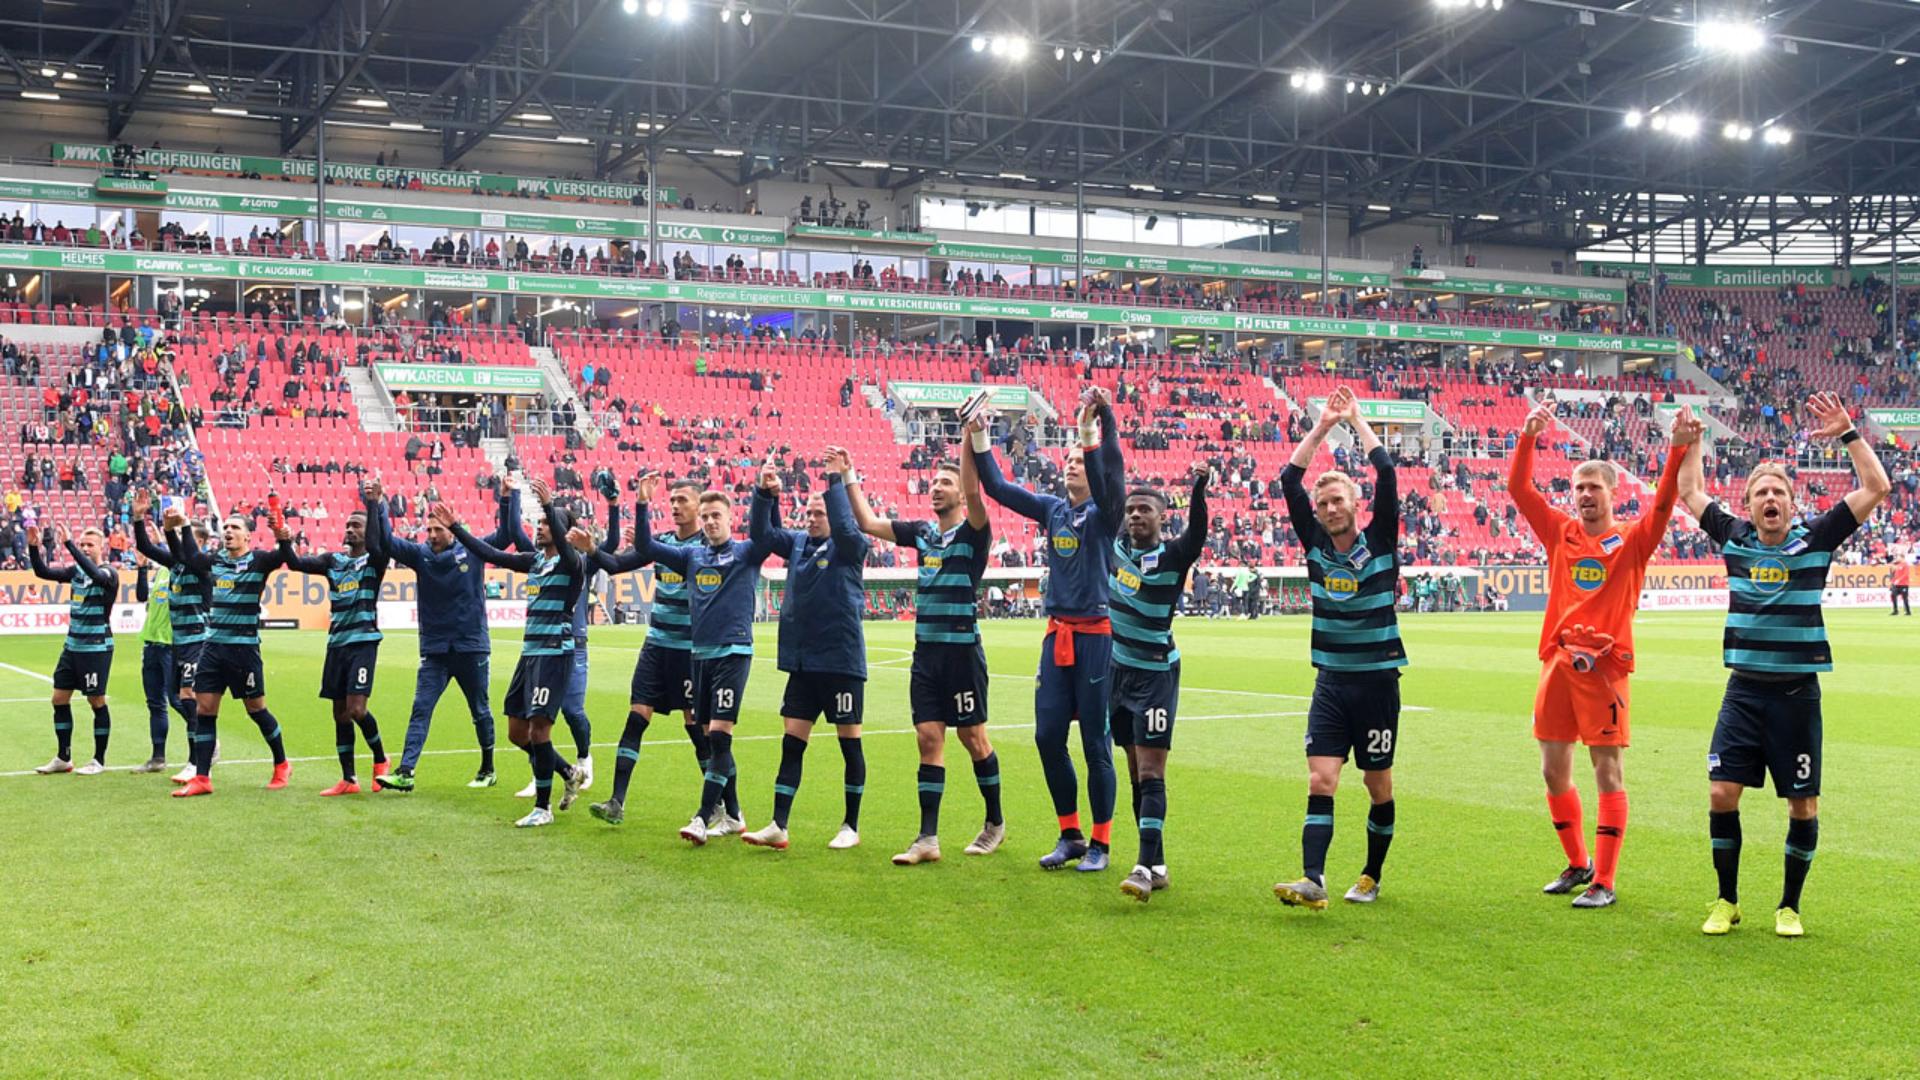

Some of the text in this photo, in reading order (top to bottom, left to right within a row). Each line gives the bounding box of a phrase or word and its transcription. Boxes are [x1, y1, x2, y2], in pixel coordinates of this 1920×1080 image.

[282, 161, 313, 176] EINE
[517, 179, 549, 194] WWK
[178, 195, 219, 208] VARTA
[251, 200, 279, 209] LOTTO
[61, 253, 105, 264] HELMES
[949, 248, 1033, 262] Stadtsparkasse Augsburg
[1083, 255, 1106, 265] Audi
[252, 265, 313, 277] FC AUGSBURG
[1714, 270, 1824, 285] Familienblock
[851, 296, 875, 307] WWK
[878, 298, 961, 312] VERSICHERUNGEN
[1050, 307, 1089, 320] Sortimo
[1255, 318, 1290, 330] FILTER
[1570, 565, 1607, 583] TEDi
[1750, 566, 1791, 583] TEDi
[85, 673, 97, 688] 14
[247, 672, 255, 688] 4
[357, 668, 367, 684] 8
[531, 687, 550, 705] 20
[716, 688, 735, 709] 13
[835, 692, 853, 713] 10
[954, 691, 975, 713] 15
[1145, 708, 1167, 732] 16
[1608, 703, 1618, 725] 1
[1367, 729, 1392, 754] 28
[1797, 753, 1812, 779] 3
